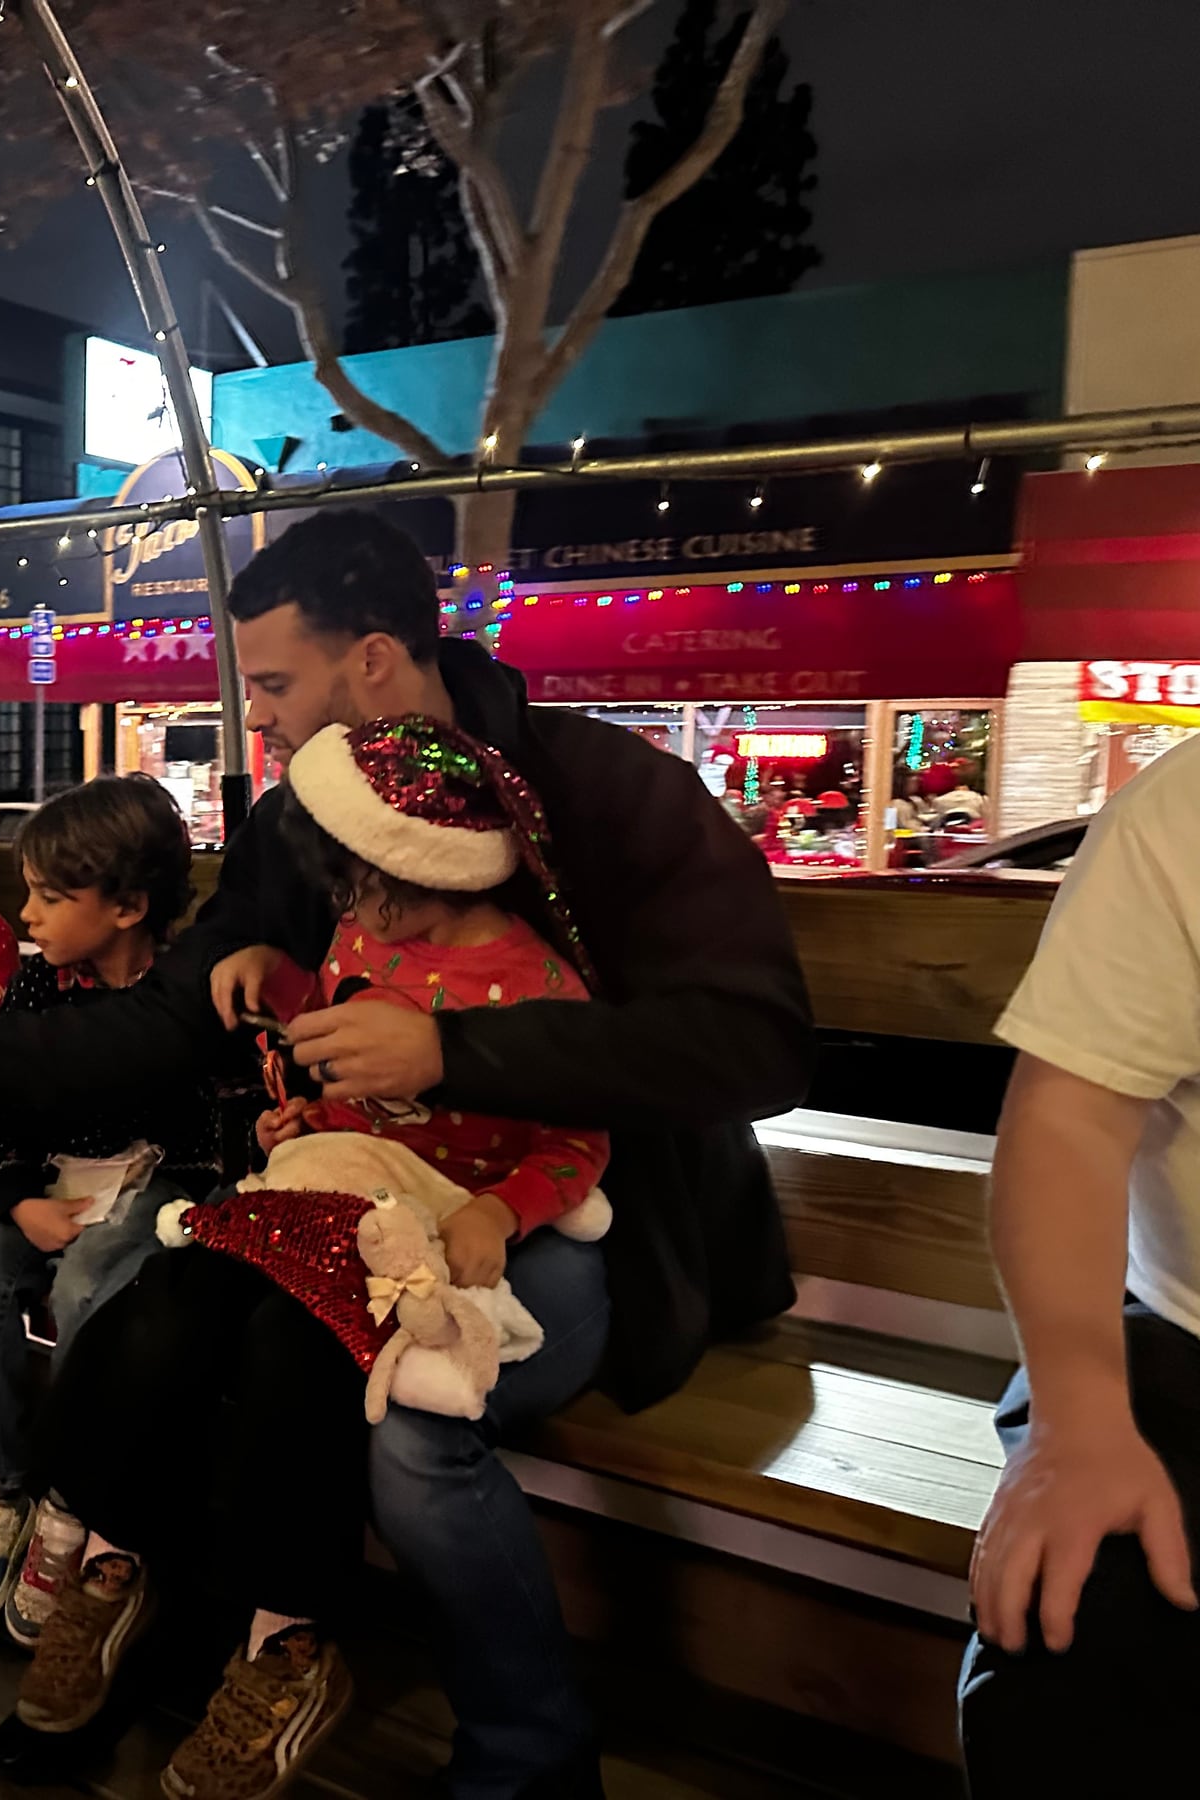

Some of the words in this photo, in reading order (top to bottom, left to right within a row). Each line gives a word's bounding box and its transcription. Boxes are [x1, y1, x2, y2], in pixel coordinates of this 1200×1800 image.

[543, 538, 675, 569] CHINESE
[681, 526, 818, 558] CUISINE
[131, 578, 208, 597] RESTAUR
[621, 627, 782, 654] CATERING
[698, 671, 779, 696] TAKE
